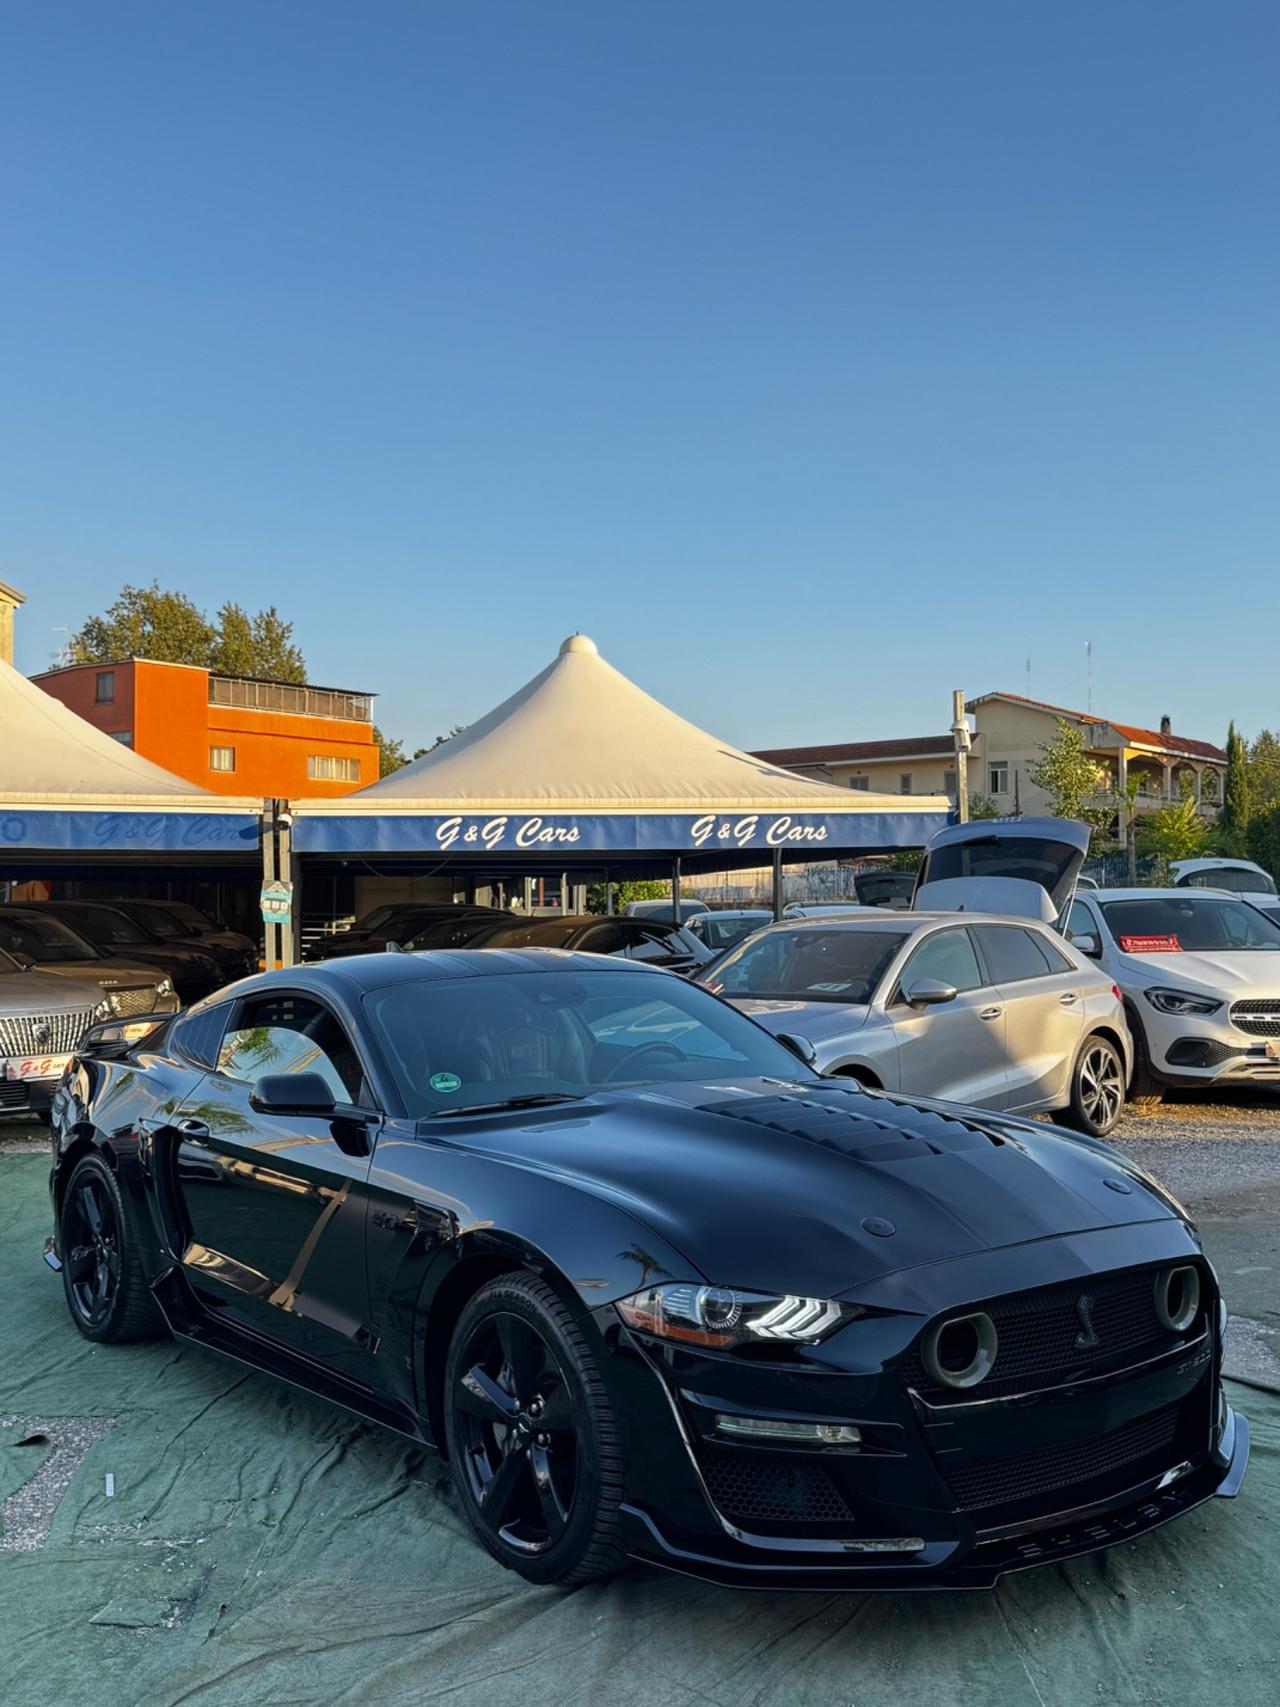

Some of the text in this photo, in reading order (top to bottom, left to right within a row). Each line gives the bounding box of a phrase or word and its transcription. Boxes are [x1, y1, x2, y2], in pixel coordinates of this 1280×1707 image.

[182, 817, 250, 846] Car
[435, 816, 581, 850] G&G Cars
[690, 814, 829, 849] G&G Cars
[1016, 1489, 1187, 1559] SHELBY
